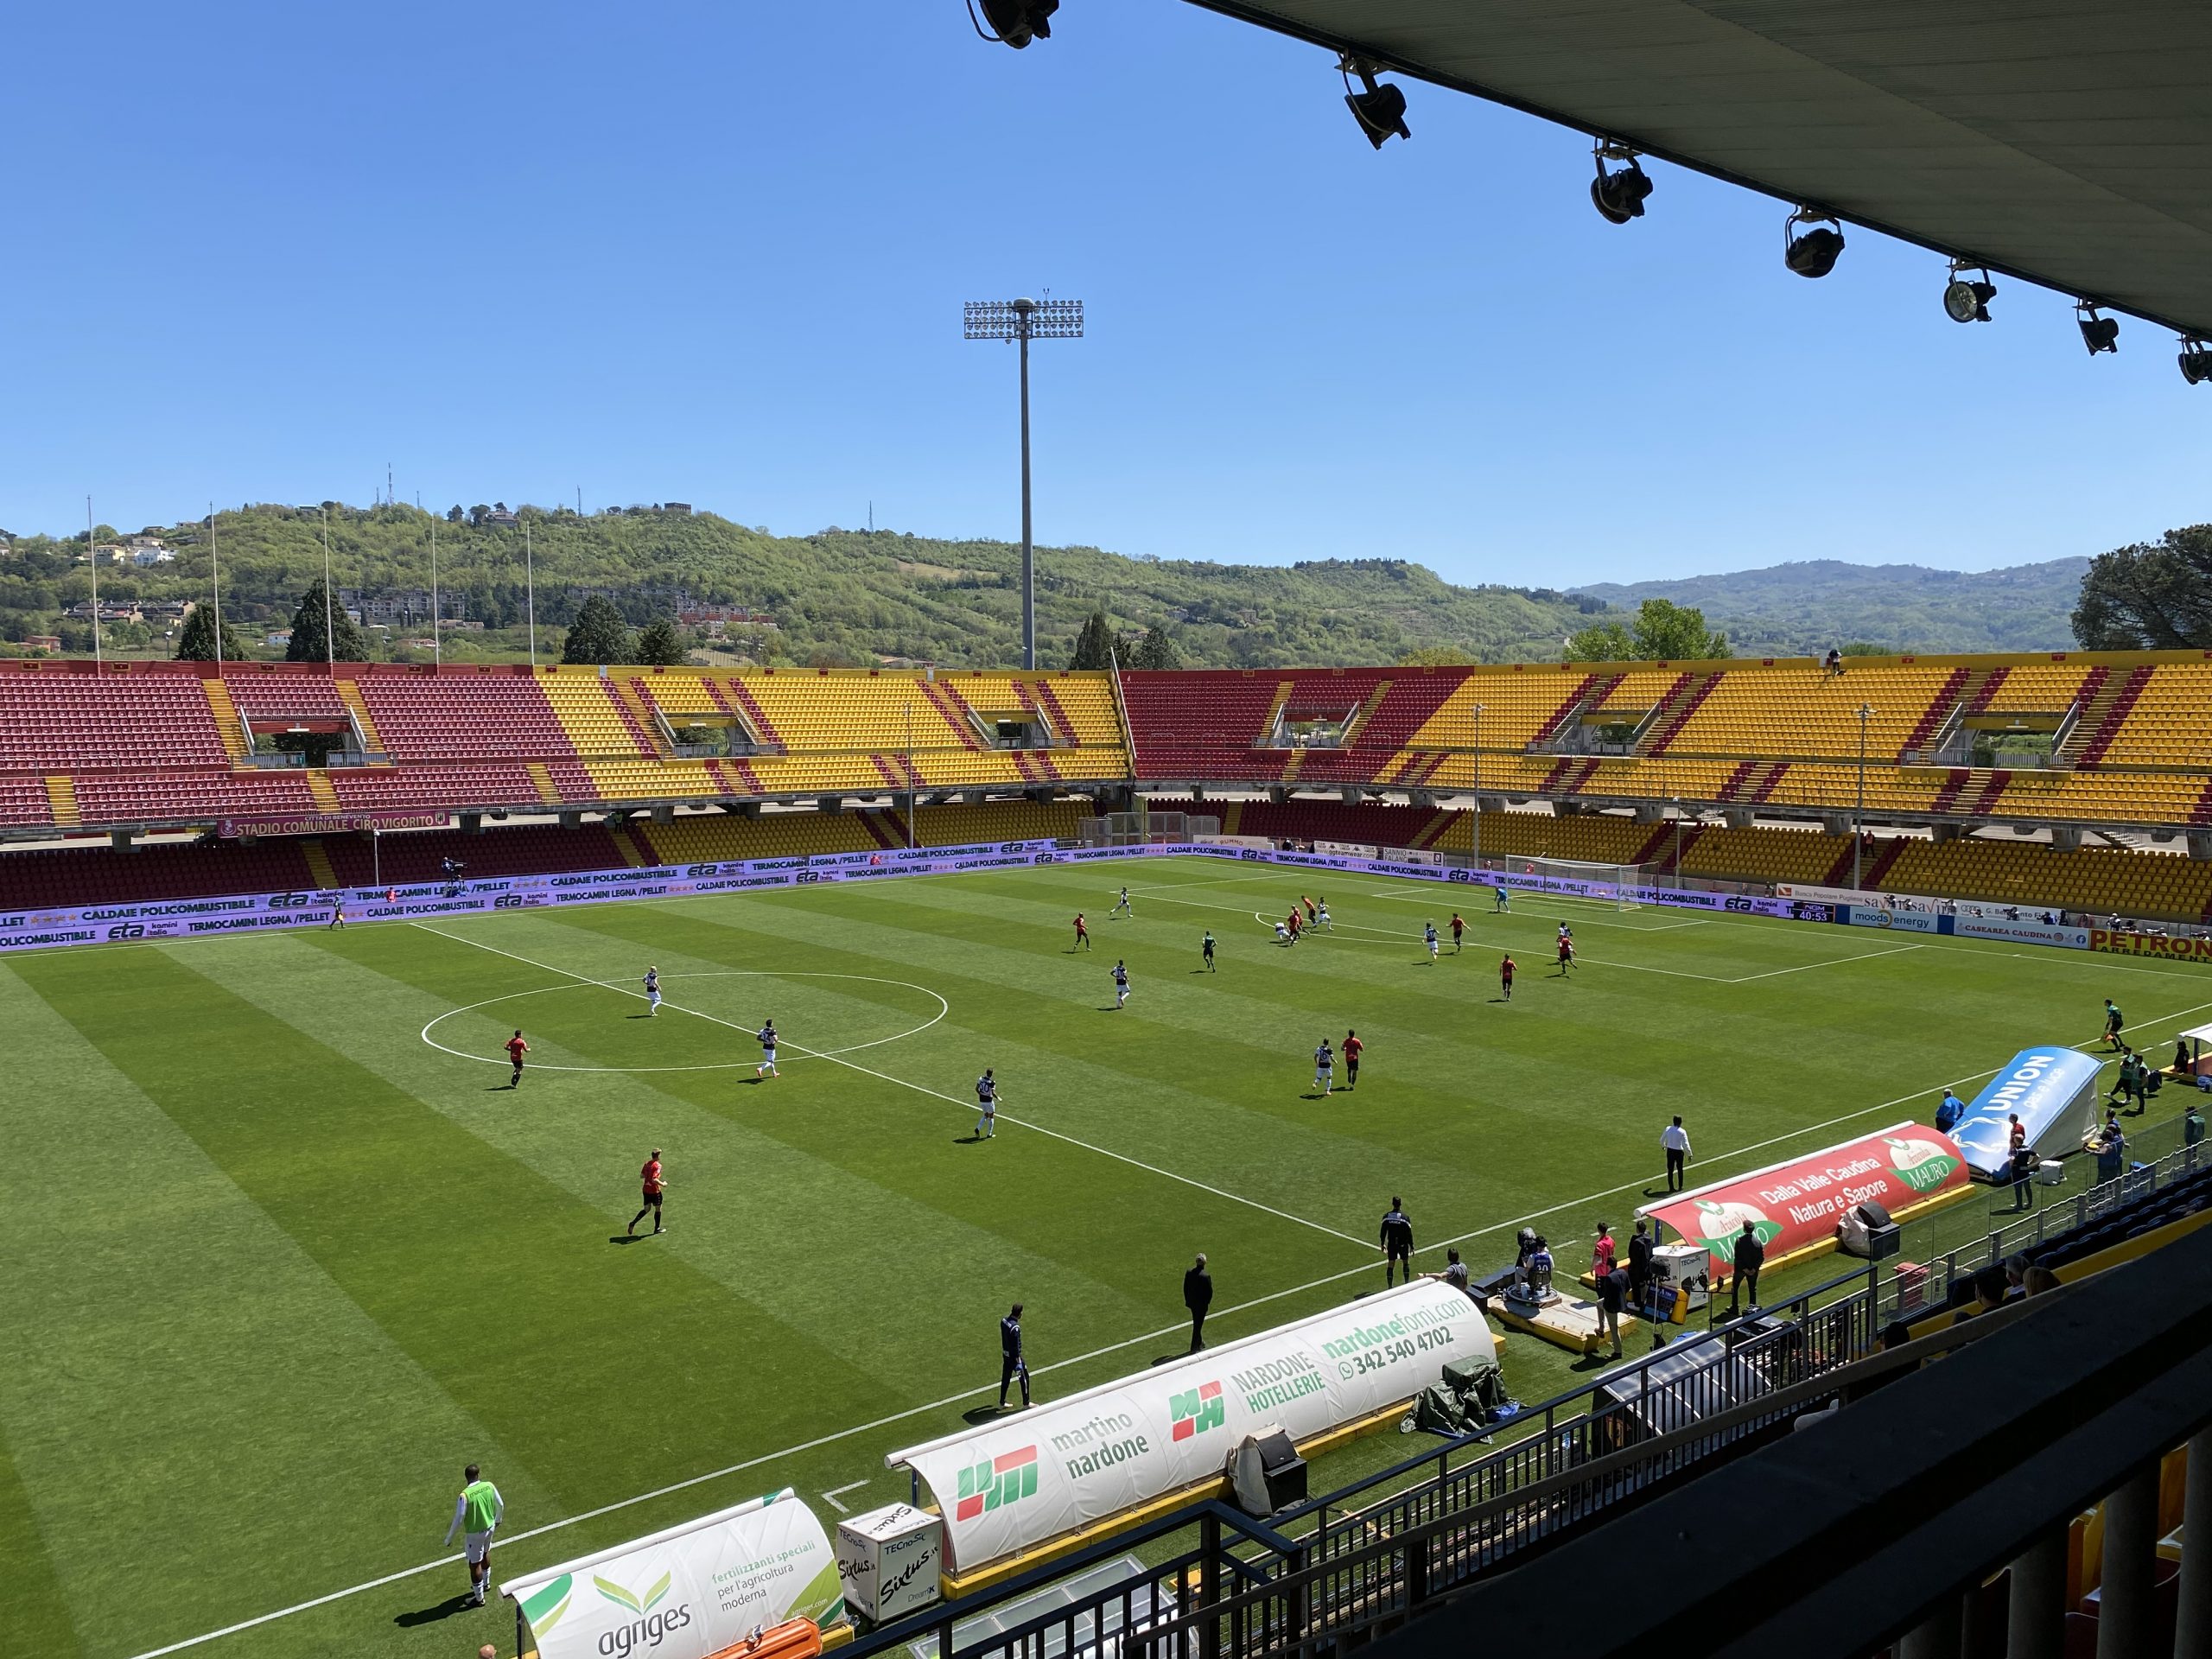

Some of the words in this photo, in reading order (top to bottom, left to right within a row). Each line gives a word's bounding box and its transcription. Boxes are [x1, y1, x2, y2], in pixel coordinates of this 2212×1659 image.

[237, 823, 280, 836] STADIO
[283, 820, 348, 834] COMUNALE
[353, 818, 379, 830] CIRO
[381, 816, 433, 829] VIGORITO
[898, 851, 928, 860] CALDAIE
[930, 847, 994, 857] POLICOMBUSTIBILE
[1001, 842, 1023, 852] eta
[1193, 847, 1237, 856] POLICOMBUSTIBILE
[1242, 849, 1257, 860] eta
[955, 860, 978, 869] CALDAIE
[979, 857, 1029, 867] POLICOMBUSTIBILE
[1034, 852, 1053, 863] eta
[1310, 857, 1327, 866] LEGNA
[687, 864, 717, 876] eta
[797, 870, 818, 882] eta
[845, 864, 887, 878] TERMOCAMINI
[888, 866, 908, 874] LEGNA
[1368, 863, 1390, 873] CALDAIE
[1390, 866, 1442, 878] POLICOMBUSTIBILE
[1449, 868, 1469, 881] eta
[550, 876, 591, 887] CALDAIE
[594, 869, 677, 883] POLICOMBUSTIBILE
[696, 880, 725, 891] CALDAIE
[727, 876, 789, 888] POLICOMBUSTIBILE
[268, 893, 308, 907] eta
[494, 893, 522, 907] eta
[556, 892, 609, 902] TERMOCAMINI
[612, 888, 637, 898] LEGNA
[1647, 891, 1717, 906] POLICOMBUSTIBILE
[81, 908, 137, 921] CALDAIE
[141, 899, 255, 917] POLICOMBUSTIBILE
[367, 906, 404, 918] CALDAIE
[406, 900, 485, 914] POLICOMBUSTIBILE
[1725, 896, 1752, 911] eta
[0, 917, 26, 927] LET
[188, 918, 257, 931] TERMOCAMINI
[260, 915, 292, 926] LEGNA
[294, 912, 330, 924] /PELLET
[1799, 911, 1827, 921] 40:53
[1855, 912, 1889, 923] moods
[1893, 916, 1929, 929] energy
[108, 924, 144, 939] eta
[1965, 925, 2010, 936] CASEAREA
[2012, 930, 2052, 940] CAUDINA
[1980, 1055, 2055, 1110] UNION
[1759, 1183, 1802, 1205] Dalla
[1795, 1173, 1833, 1192] Valle
[1825, 1156, 1882, 1182] Caudina
[1906, 1160, 1949, 1191] MAURO
[1789, 1198, 1834, 1225] Natura
[1835, 1196, 1846, 1209] e
[1845, 1179, 1888, 1205] Sapore
[1321, 1298, 1471, 1358] nardoneforni.com
[1352, 1350, 1387, 1375] 342
[1385, 1339, 1416, 1363] 540
[1417, 1325, 1454, 1352] 4702
[1231, 1351, 1315, 1393] NARDONE
[1246, 1371, 1326, 1414] HOTELLERIE
[1051, 1411, 1133, 1452] martino
[1065, 1433, 1149, 1479] nardone
[711, 1554, 774, 1584] fertilizzanti
[776, 1541, 816, 1562] speciali
[717, 1586, 734, 1599] per
[736, 1563, 794, 1591] l'agricoltura
[721, 1589, 767, 1612] moderna
[790, 1599, 829, 1618] agriges.com
[598, 1604, 691, 1659] agriges
